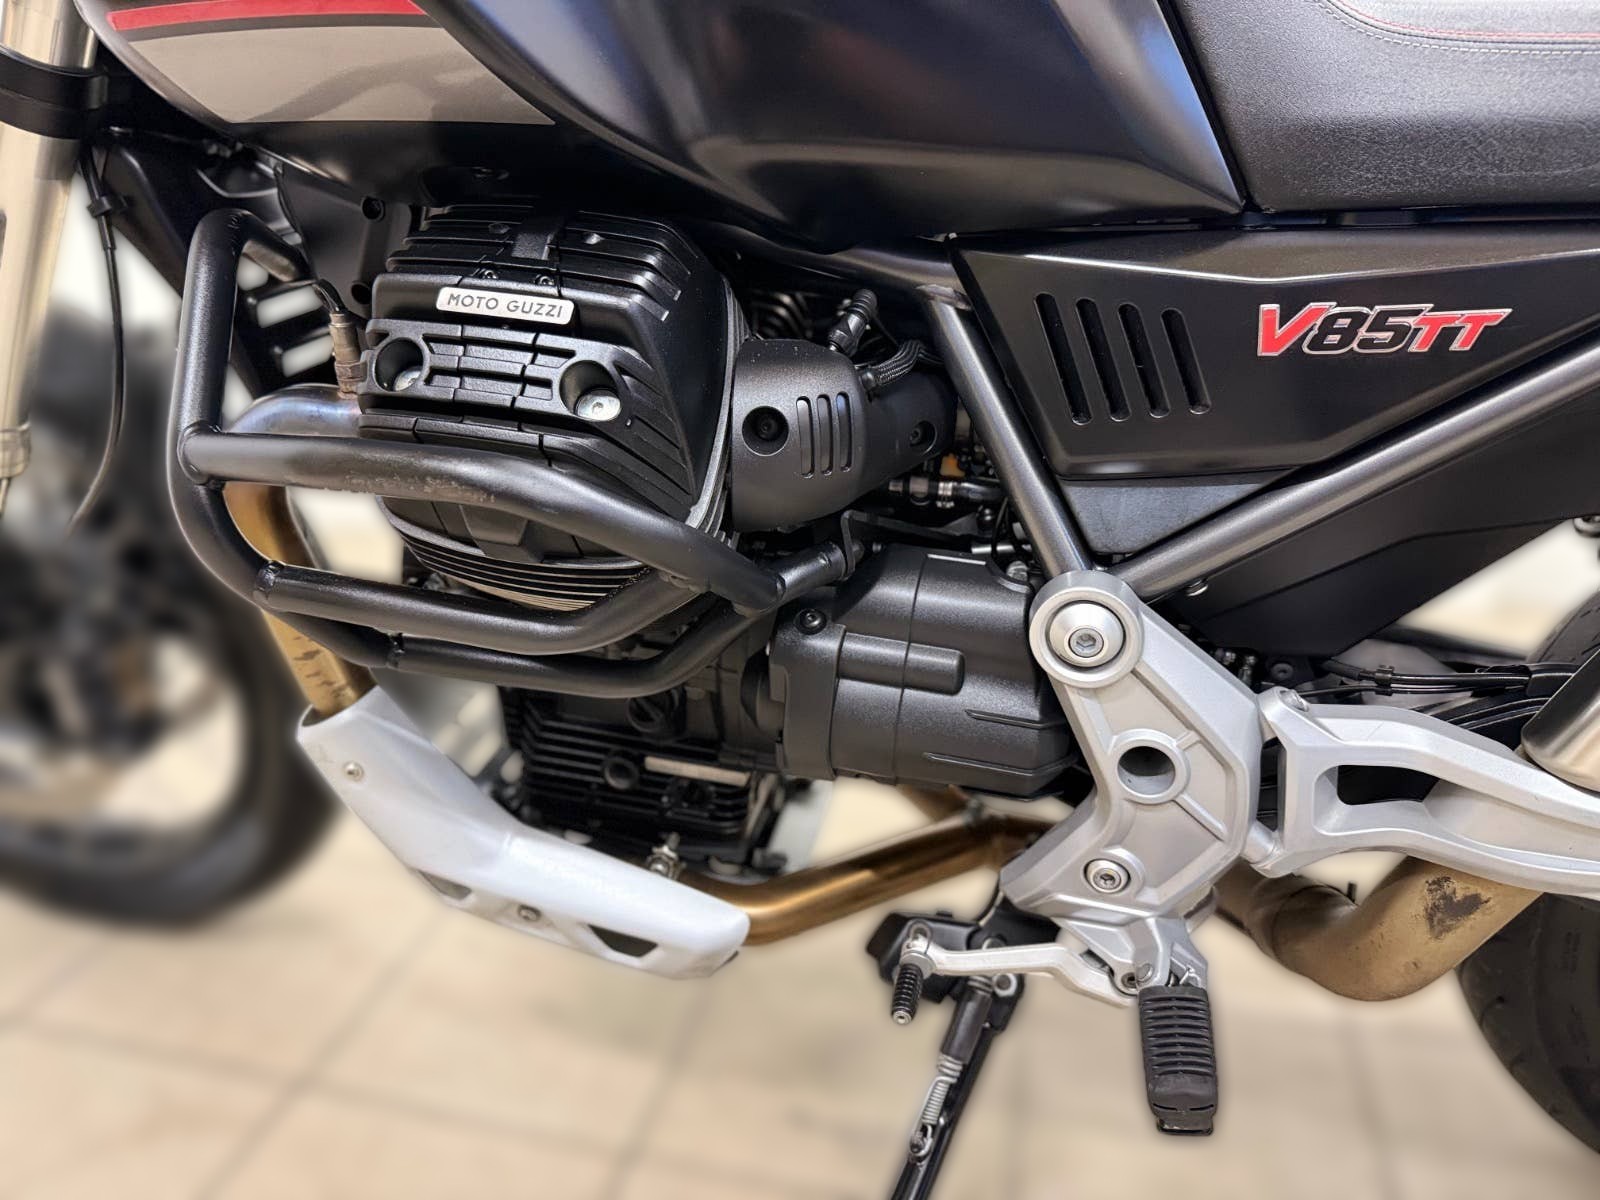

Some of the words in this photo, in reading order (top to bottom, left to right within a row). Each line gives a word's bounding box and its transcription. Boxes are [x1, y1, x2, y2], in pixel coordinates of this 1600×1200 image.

[447, 293, 498, 310] MOTO
[506, 300, 563, 318] GUZZI
[1257, 301, 1513, 356] V85TT
